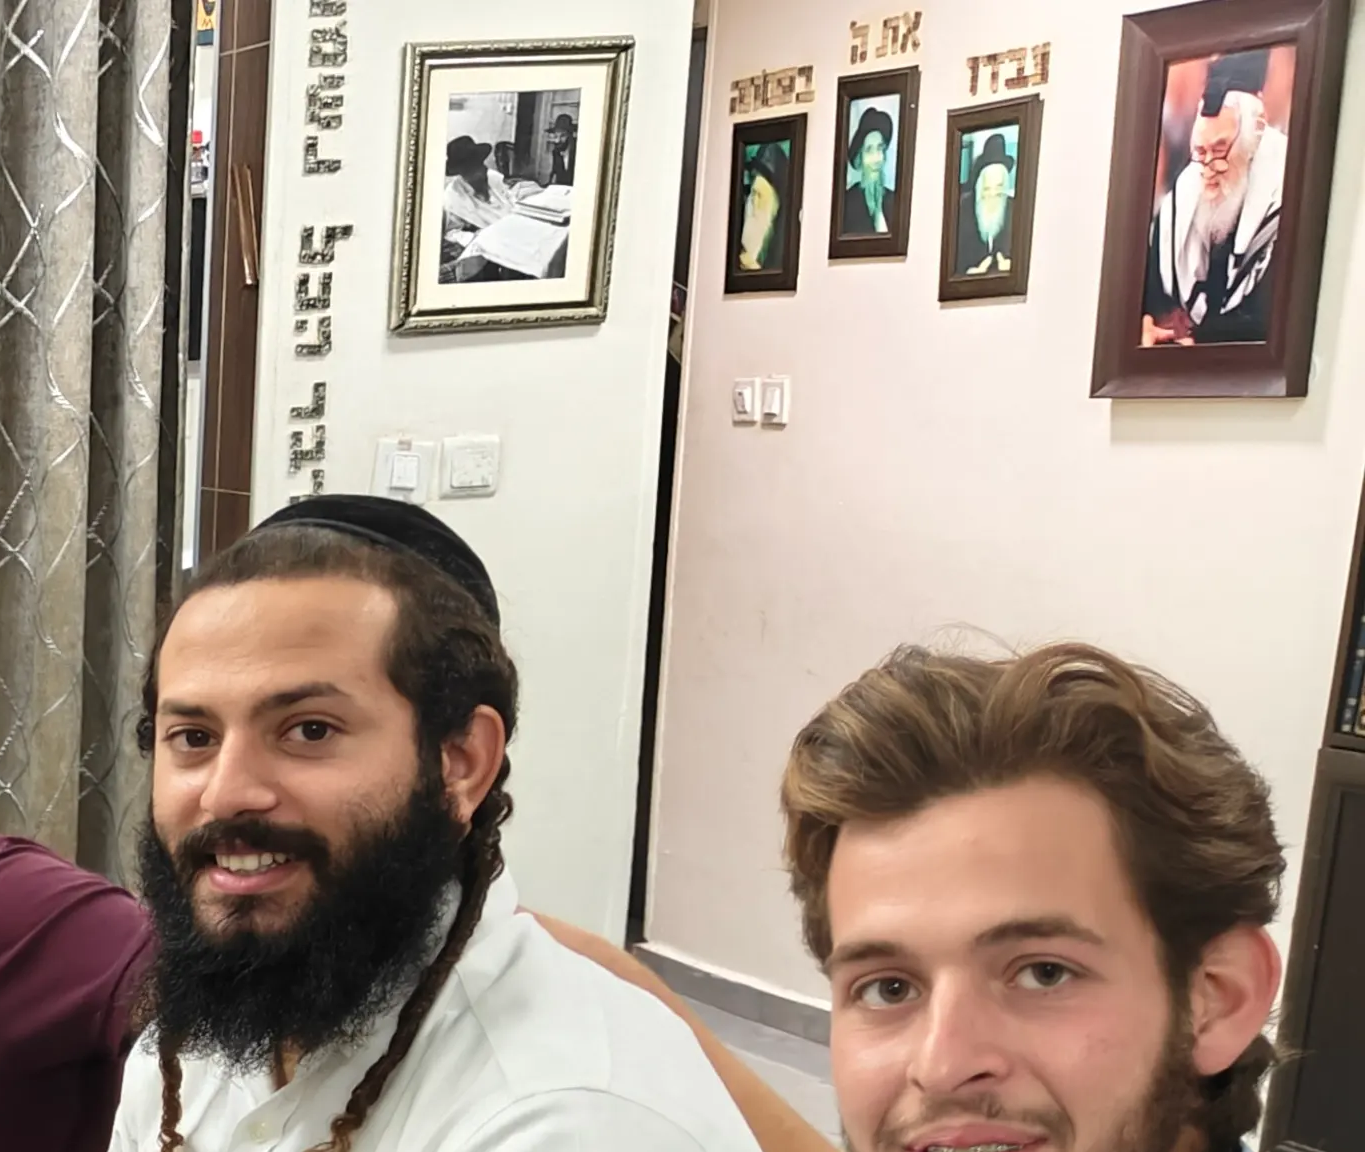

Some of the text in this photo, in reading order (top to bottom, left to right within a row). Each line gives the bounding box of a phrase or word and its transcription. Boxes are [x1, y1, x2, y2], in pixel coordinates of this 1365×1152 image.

[875, 11, 922, 58] את
[967, 42, 1050, 96] עבדו
[294, 224, 355, 359] הכל
